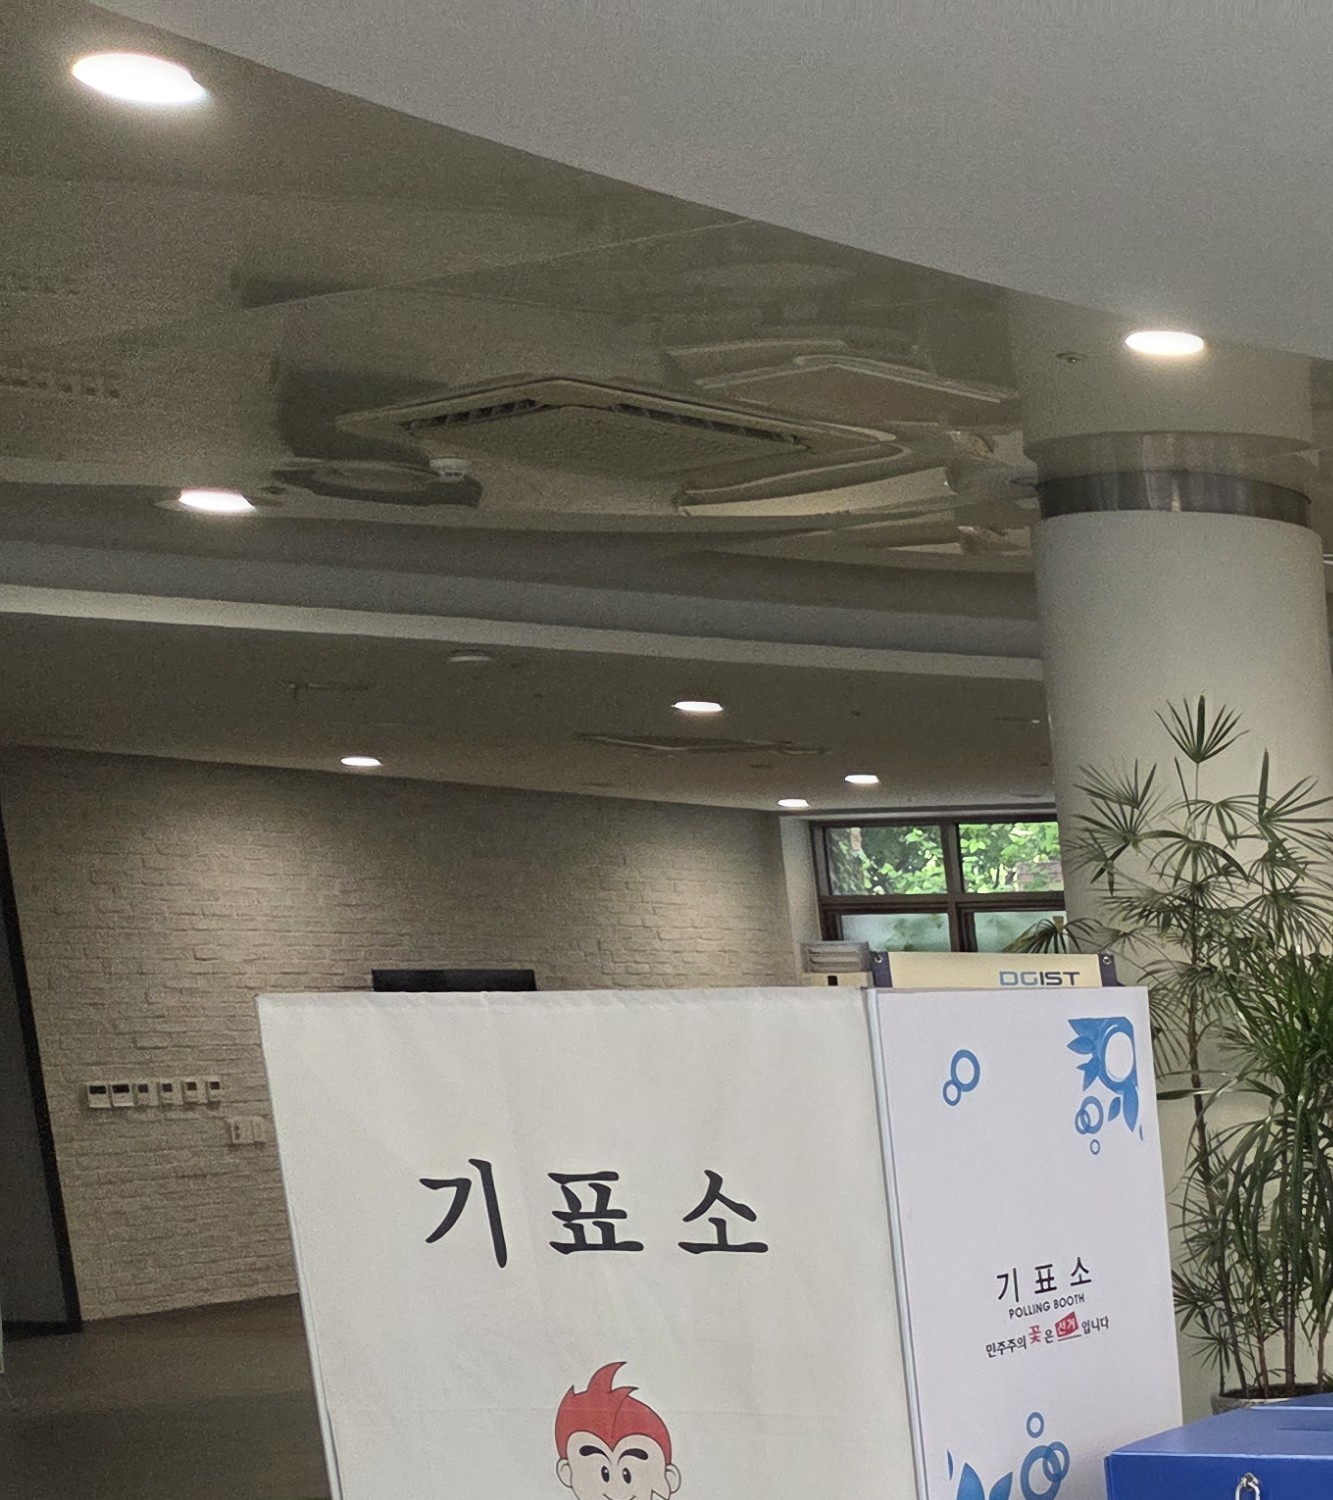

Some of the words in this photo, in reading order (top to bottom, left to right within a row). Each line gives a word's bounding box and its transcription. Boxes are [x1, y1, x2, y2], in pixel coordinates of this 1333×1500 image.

[1000, 971, 1080, 986] DGIST
[1008, 1301, 1050, 1319] POLLING
[1053, 1293, 1085, 1309] BOOTH
[985, 1335, 1027, 1358] 민주주의
